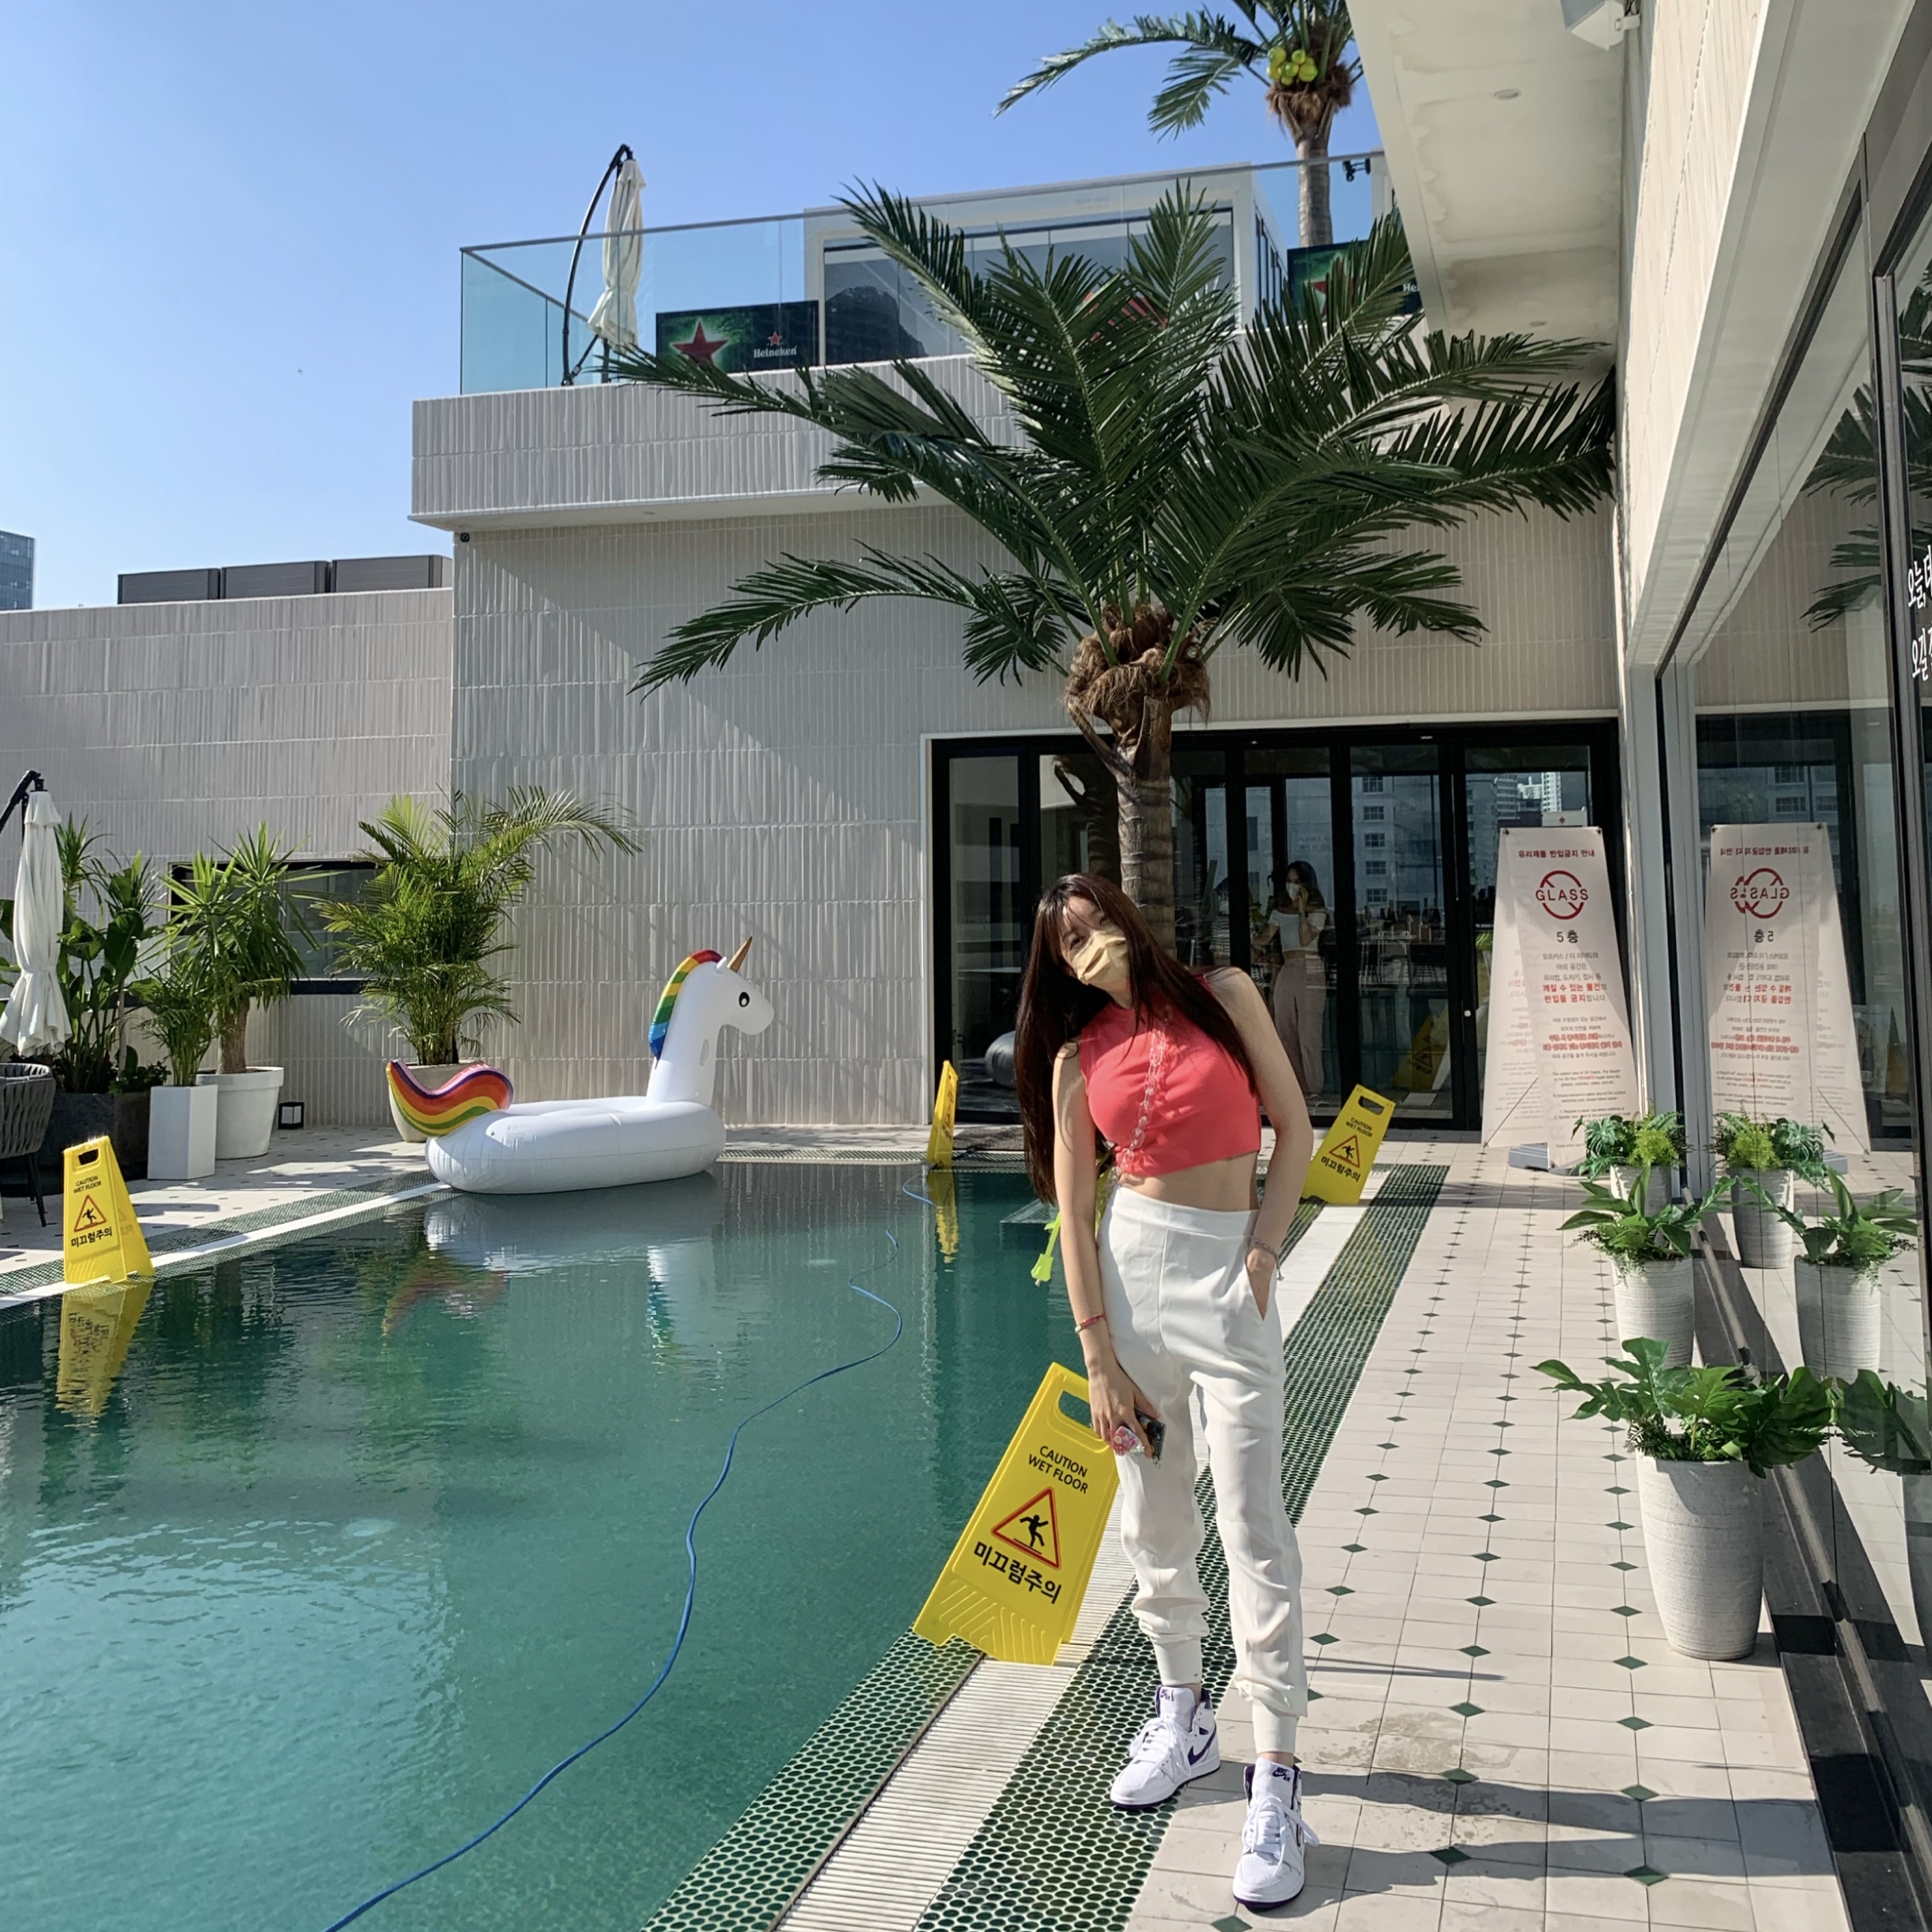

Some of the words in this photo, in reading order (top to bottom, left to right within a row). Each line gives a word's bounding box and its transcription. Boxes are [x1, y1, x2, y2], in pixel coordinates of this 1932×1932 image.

[1403, 283, 1419, 292] He
[754, 347, 797, 358] Heineken
[1535, 888, 1588, 901] GLASS
[1570, 983, 1584, 992] 있는
[1351, 1117, 1372, 1131] CAUTION
[1357, 1127, 1373, 1137] FLOOR
[1321, 1156, 1361, 1182] 미끄럼주의
[73, 1185, 84, 1194] WET
[85, 1180, 102, 1192] FLOOR
[76, 1175, 99, 1187] CAUTION
[70, 1227, 113, 1248] 미끄럼주의
[1039, 1445, 1088, 1478] CAUTION
[1028, 1454, 1054, 1476] WET
[1052, 1467, 1089, 1495] FLOOR
[973, 1541, 1062, 1605] 미끄럼주의
